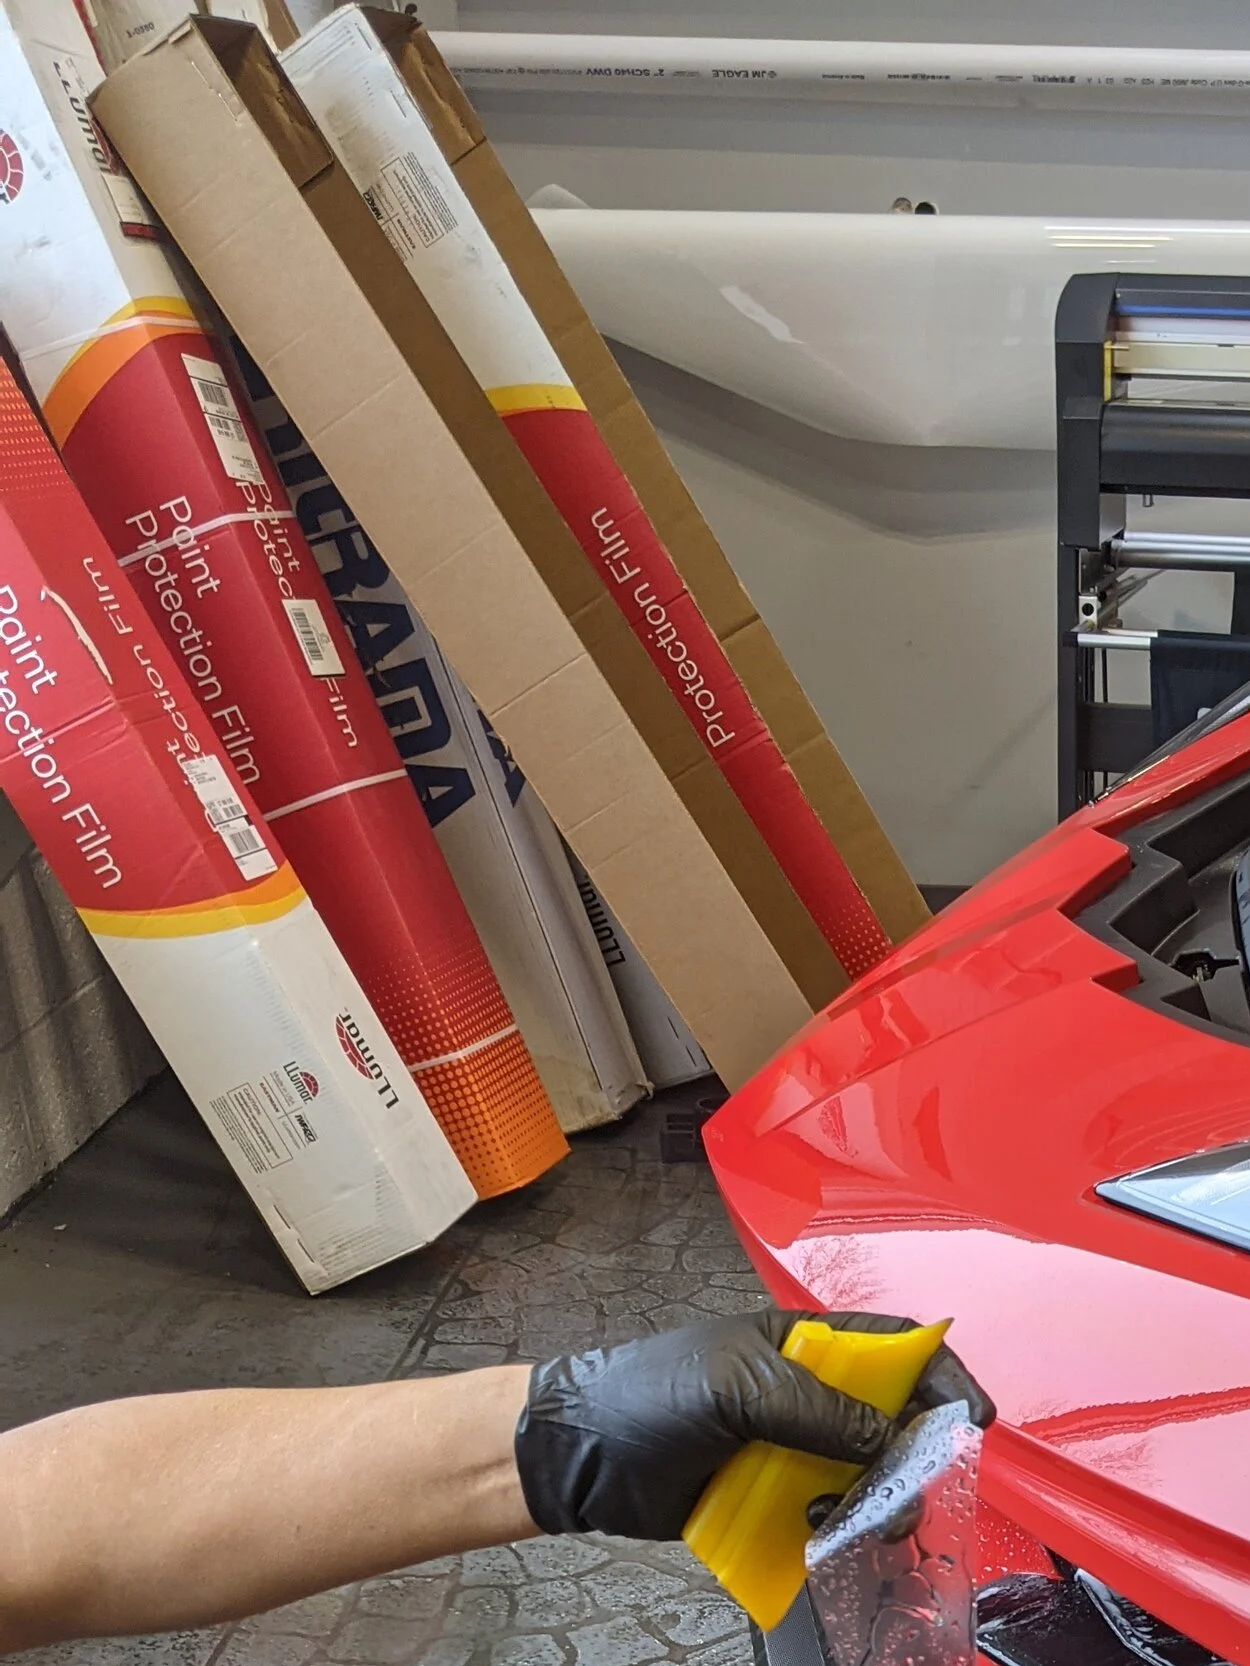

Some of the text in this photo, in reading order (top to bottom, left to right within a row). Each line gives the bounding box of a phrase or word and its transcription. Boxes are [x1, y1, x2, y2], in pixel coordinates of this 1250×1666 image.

[585, 67, 611, 75] DWV
[711, 69, 766, 78] JM EAGLE
[160, 496, 222, 599] Paint
[256, 480, 301, 571] Paint
[82, 557, 133, 635] Film
[233, 481, 358, 748] Protec Film
[590, 507, 735, 749] Protection Film
[126, 509, 224, 716] Protection
[212, 704, 261, 787] Film
[61, 802, 123, 889] Film
[282, 1060, 315, 1105] LLumar
[334, 1008, 400, 1108] LLumar
